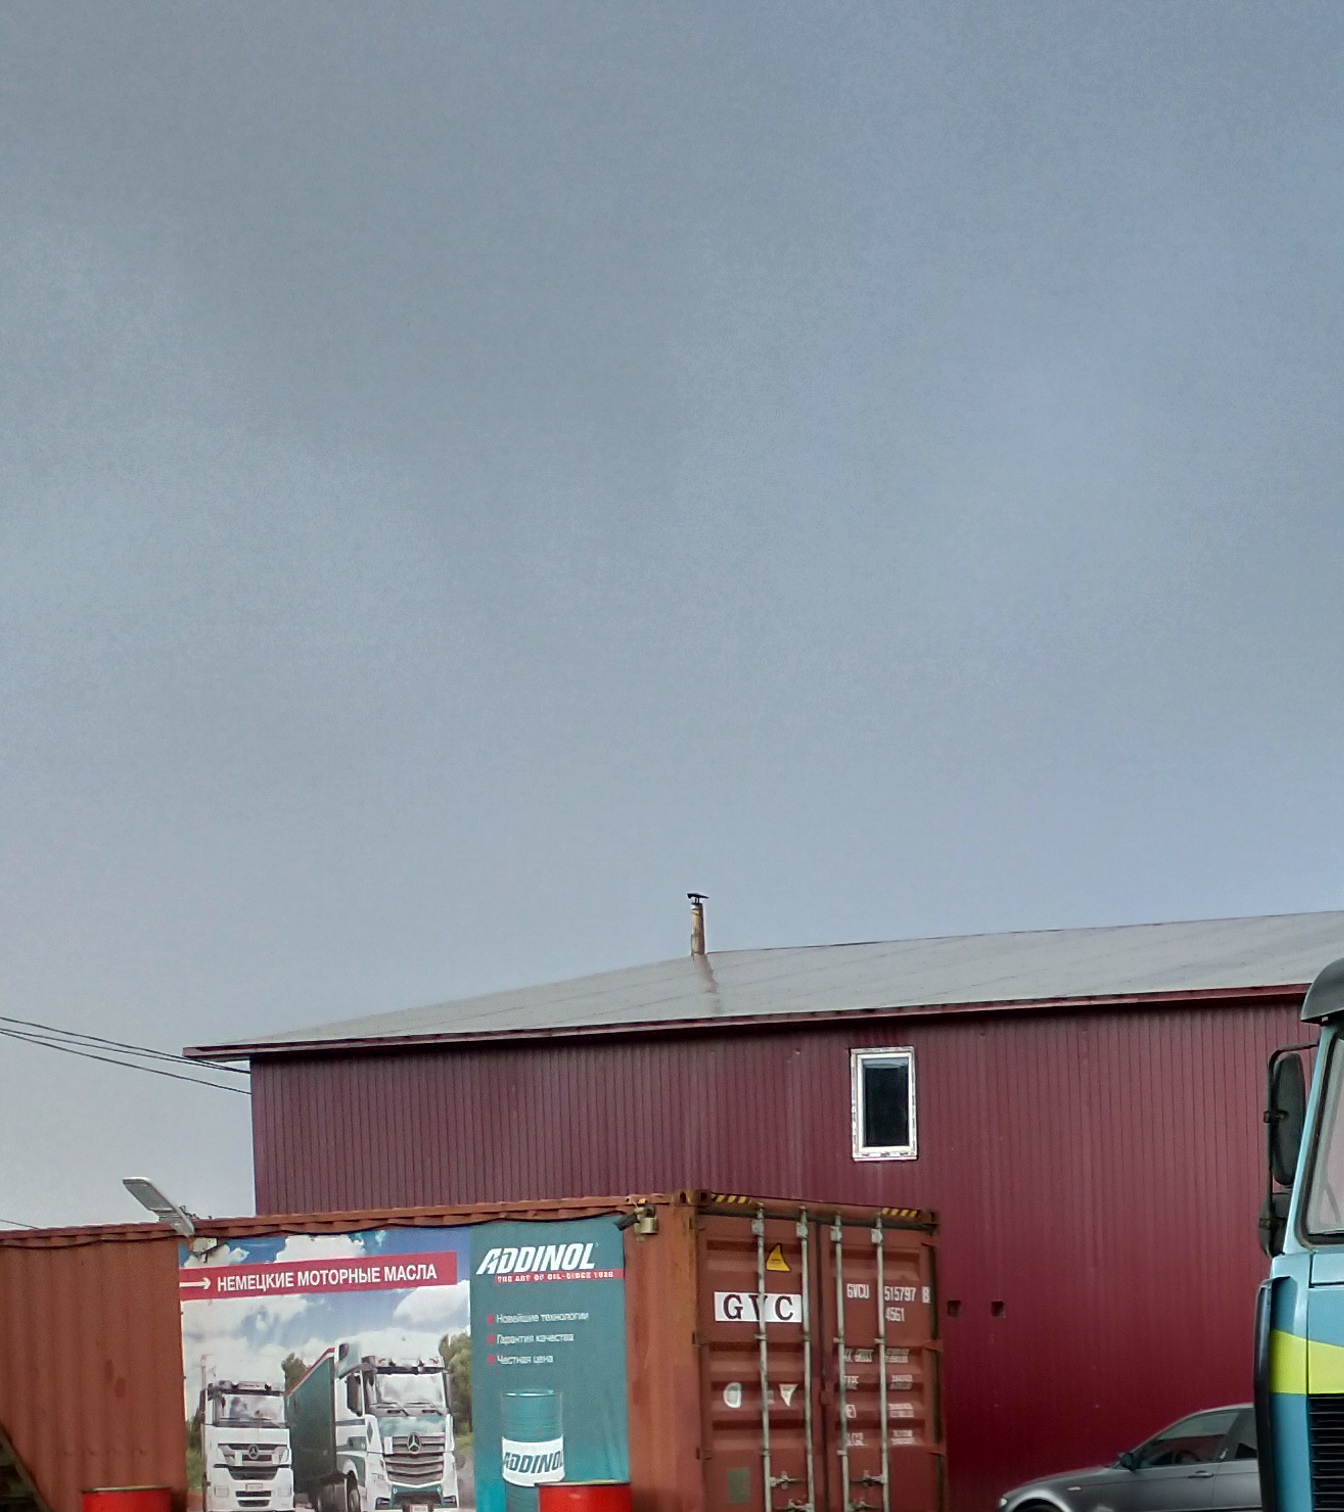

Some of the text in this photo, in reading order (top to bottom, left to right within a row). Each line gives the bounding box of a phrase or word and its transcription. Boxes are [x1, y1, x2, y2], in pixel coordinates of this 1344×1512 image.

[476, 1243, 596, 1275] ADDINOL
[216, 1263, 437, 1292] НЕМЕЦКИЕ МОТОРНЫЕ МАСЛА
[884, 1286, 917, 1301] 515797
[496, 1312, 589, 1324] Новейшие технологии
[496, 1333, 575, 1345] Гарантия качества
[497, 1355, 553, 1365] Честная цена
[503, 1450, 563, 1473] ADDINO
